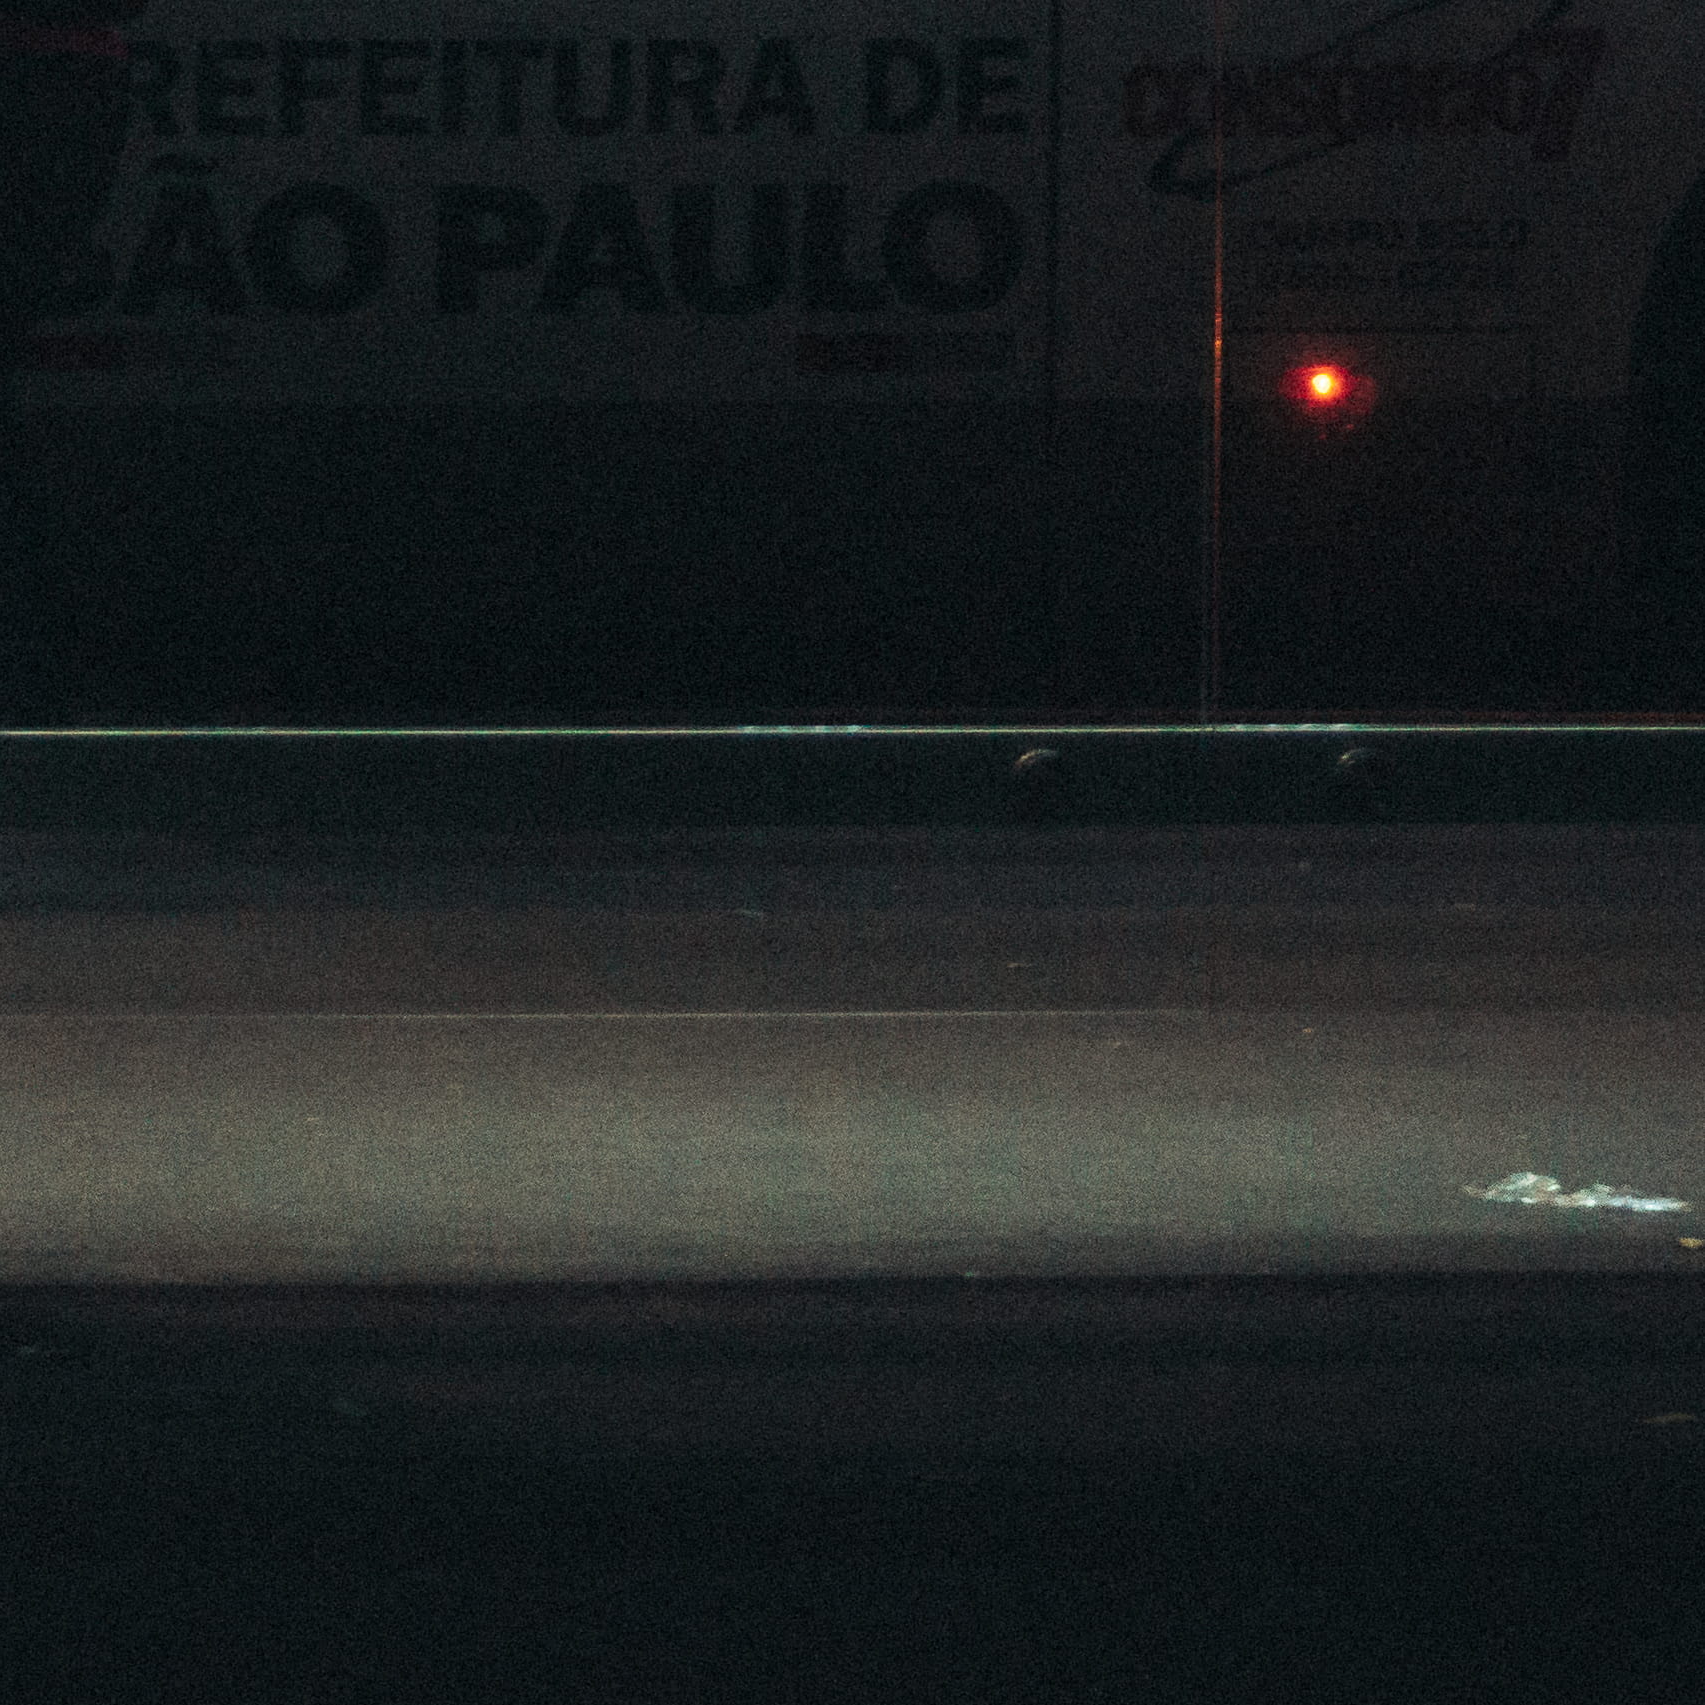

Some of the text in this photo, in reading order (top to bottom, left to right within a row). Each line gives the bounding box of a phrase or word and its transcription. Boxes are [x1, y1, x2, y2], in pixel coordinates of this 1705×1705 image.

[123, 36, 1029, 137] REFEITURA DE
[433, 179, 1026, 316] PAULO
